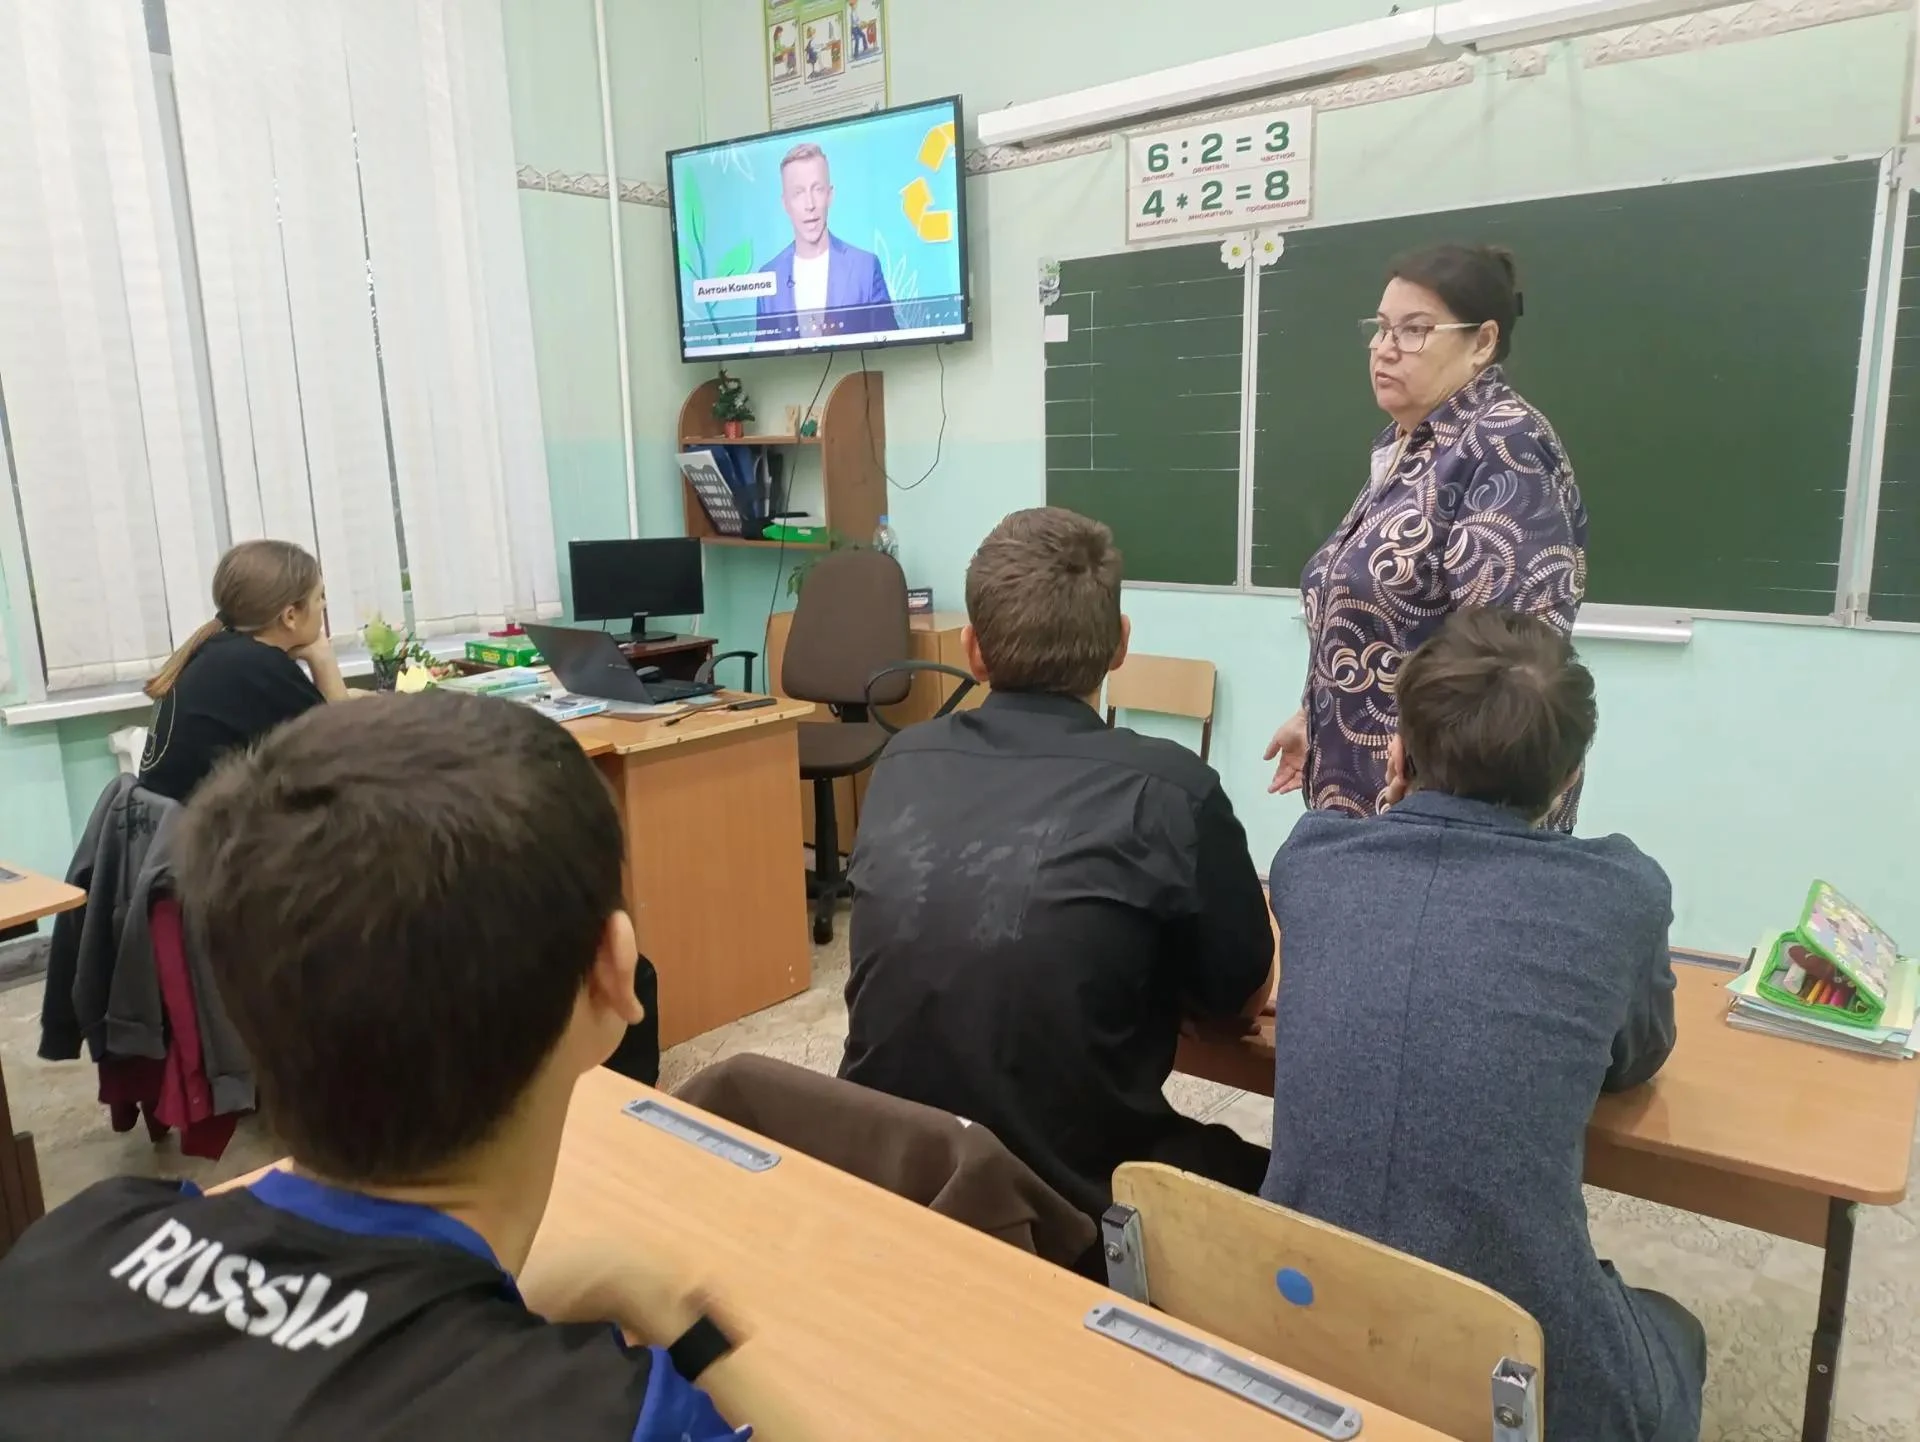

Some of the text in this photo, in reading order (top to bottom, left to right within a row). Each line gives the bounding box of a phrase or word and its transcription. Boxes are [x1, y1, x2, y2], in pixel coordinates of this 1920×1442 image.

[1148, 143, 1169, 172] 6
[1201, 133, 1223, 164] 2
[1265, 121, 1289, 152] 3
[1142, 189, 1165, 218] 4
[1201, 180, 1223, 211] 2
[1264, 170, 1289, 200] 8
[697, 282, 772, 297] Антон Комолов
[109, 1217, 369, 1352] RUSSIA
